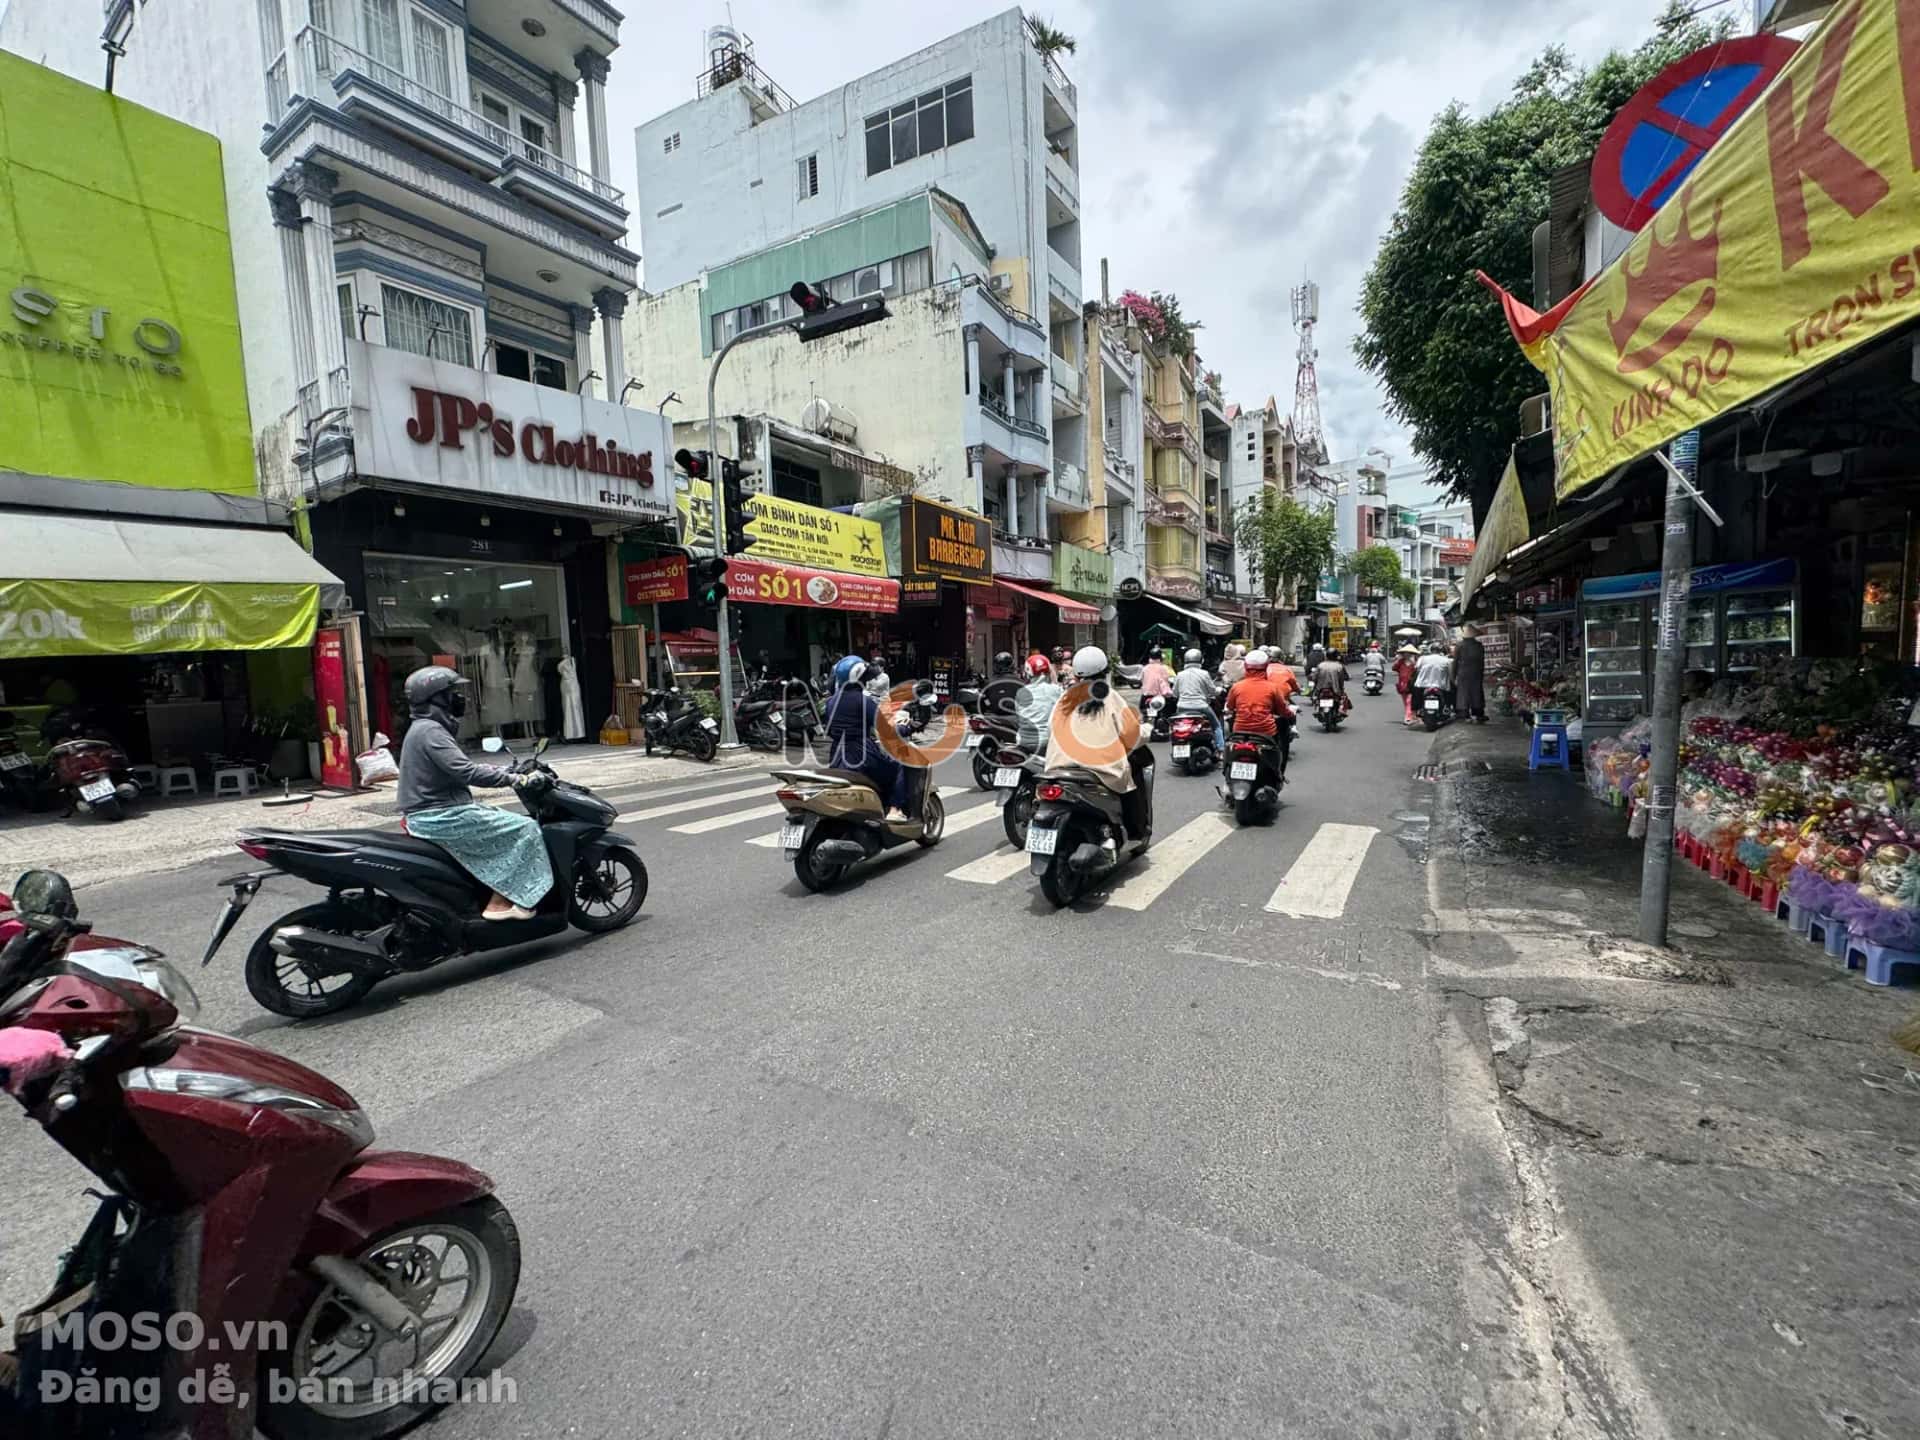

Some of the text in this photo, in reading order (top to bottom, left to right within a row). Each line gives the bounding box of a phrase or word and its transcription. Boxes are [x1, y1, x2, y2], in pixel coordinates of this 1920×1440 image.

[406, 386, 654, 488] JP's Clothing
[928, 536, 986, 570] BARBERSHOP
[737, 585, 756, 596] DÂN
[758, 567, 790, 600] SỐ
[793, 578, 802, 600] 1
